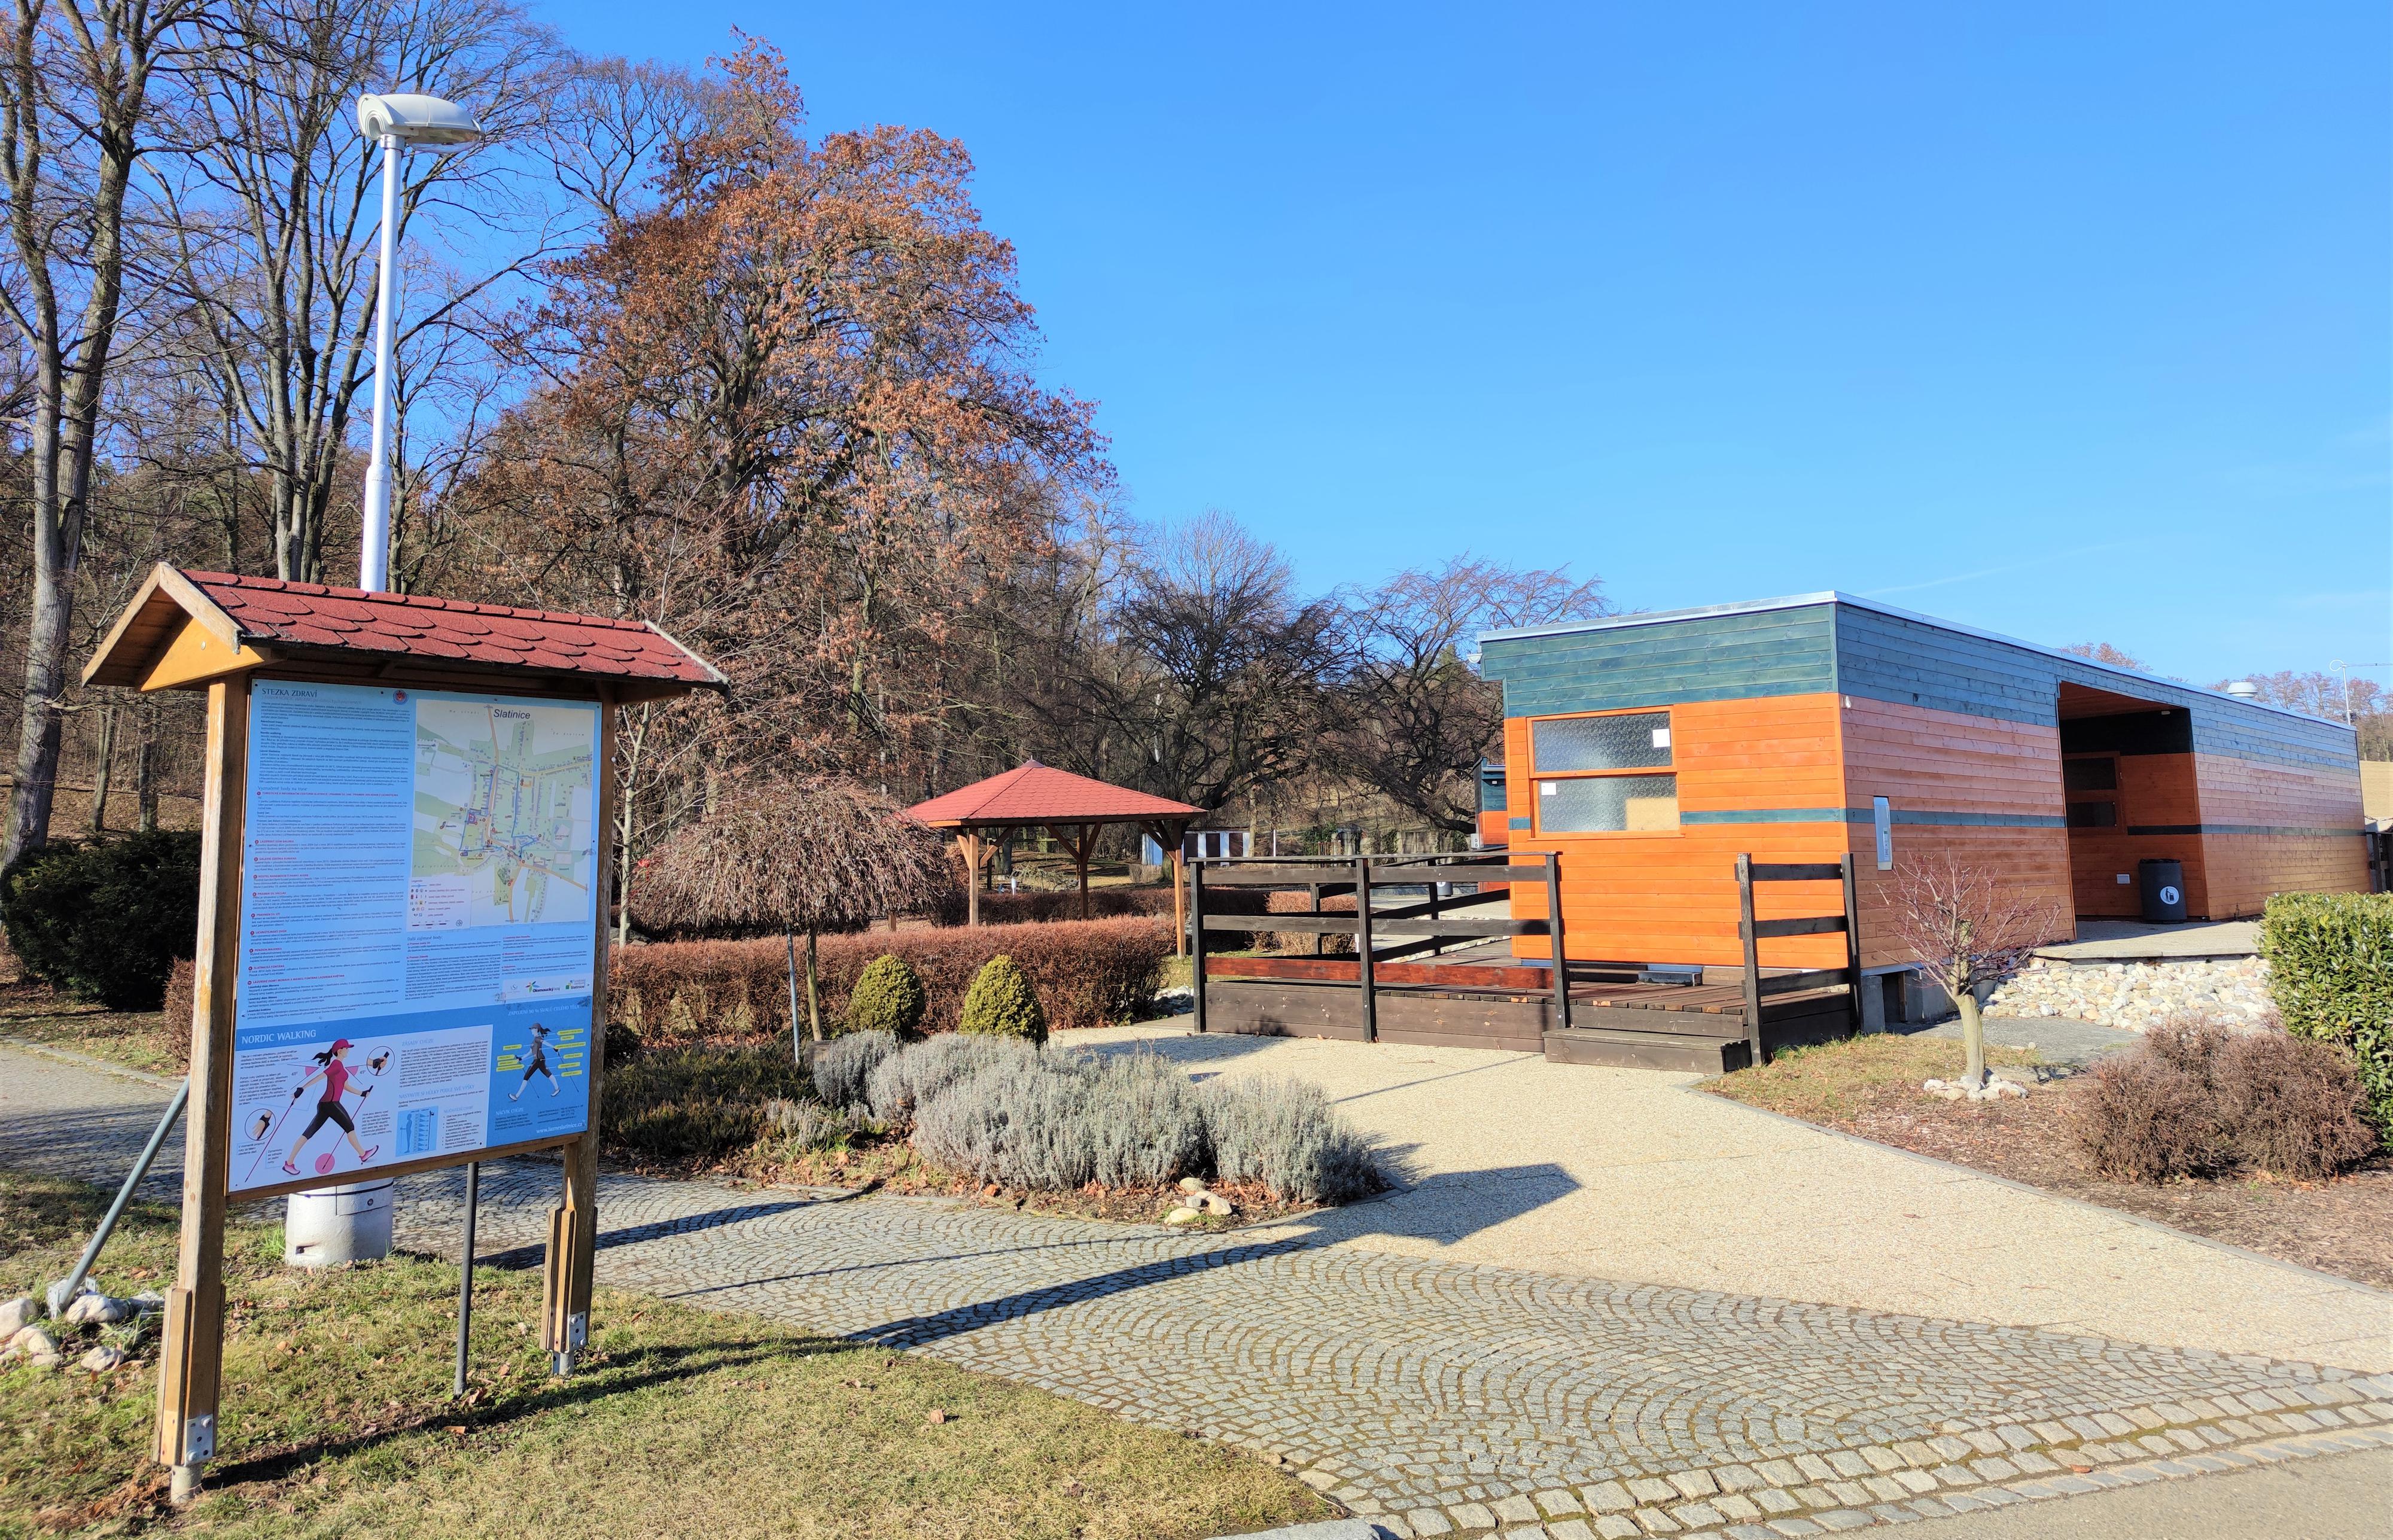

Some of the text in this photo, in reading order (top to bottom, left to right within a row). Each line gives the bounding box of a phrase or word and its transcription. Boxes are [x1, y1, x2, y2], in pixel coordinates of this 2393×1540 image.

[292, 689, 317, 698] ZDRAVÍ
[494, 708, 530, 719] Slatinice
[242, 1029, 316, 1044] NORDIC WALKING
[536, 1122, 583, 1134] www.lazneslatinice.cz
